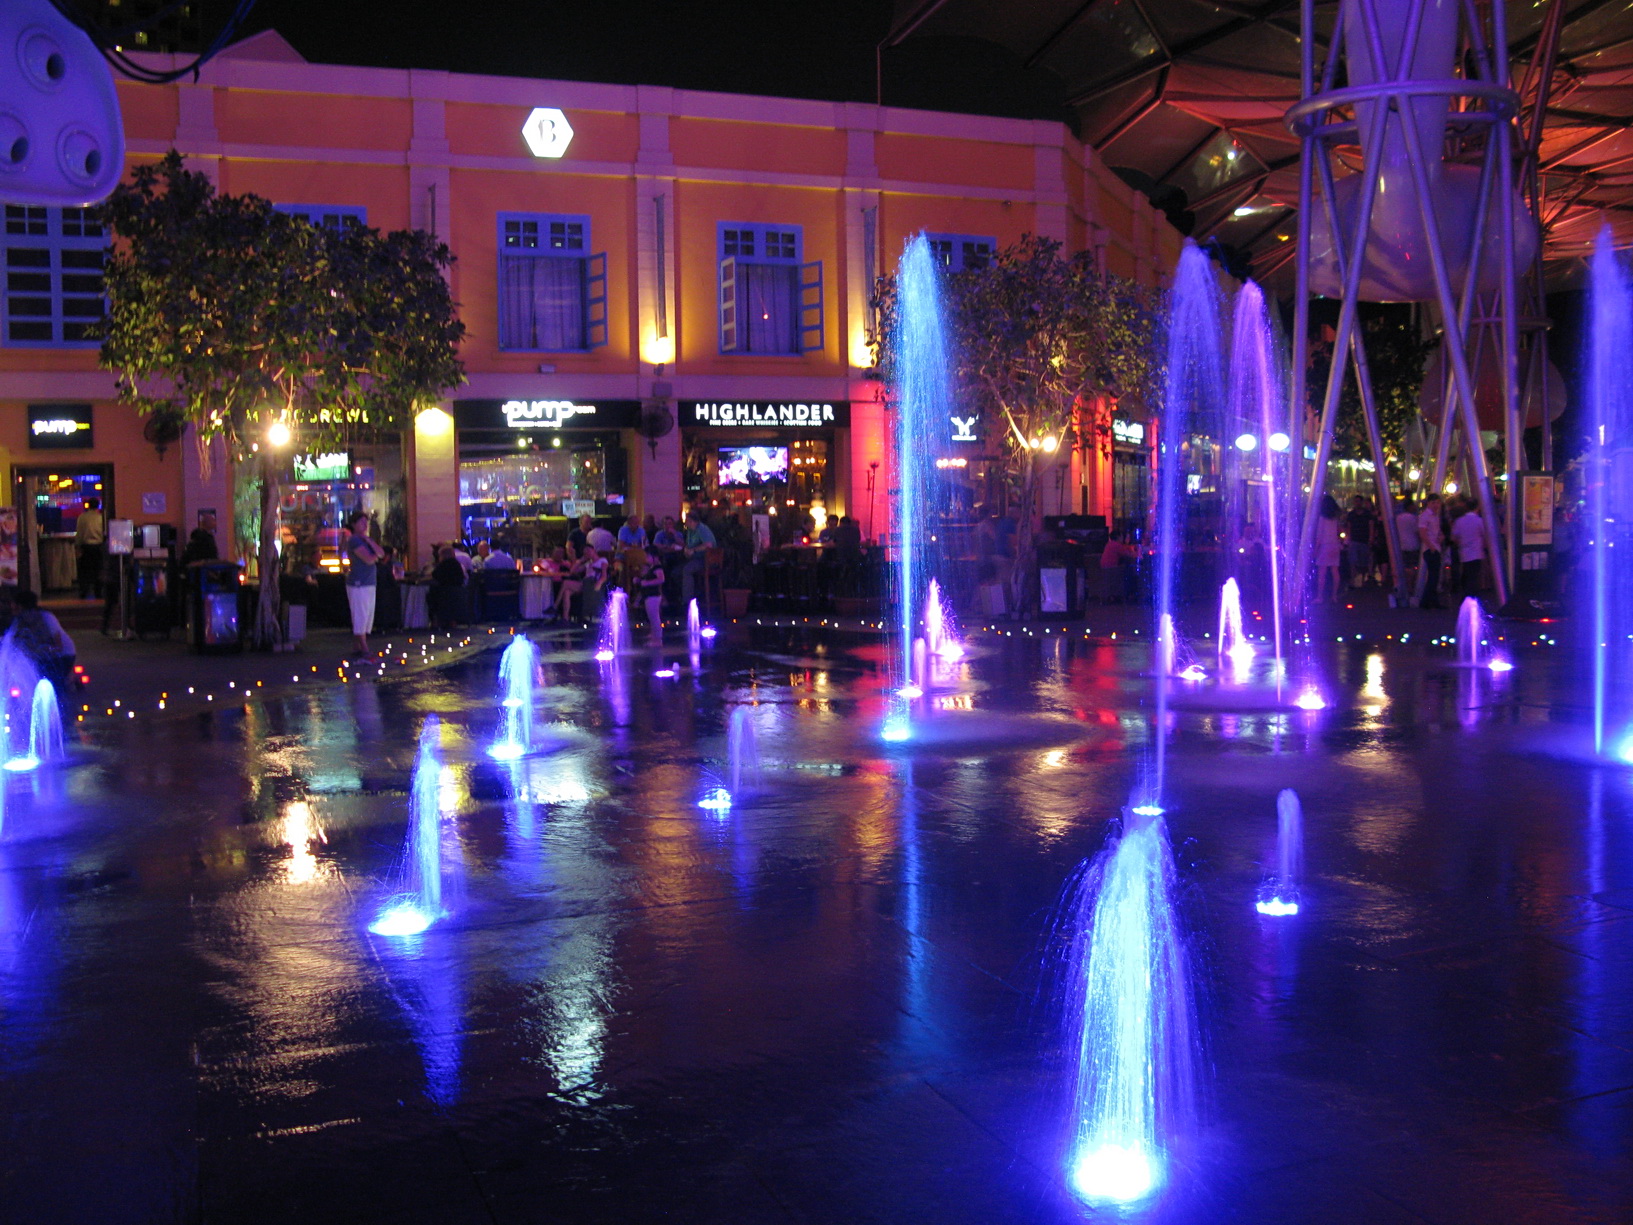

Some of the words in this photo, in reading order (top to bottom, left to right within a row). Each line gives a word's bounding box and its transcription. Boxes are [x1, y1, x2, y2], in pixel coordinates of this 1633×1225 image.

[507, 400, 575, 428] pump
[695, 403, 835, 421] HIGHLANDER
[34, 420, 77, 436] pump
